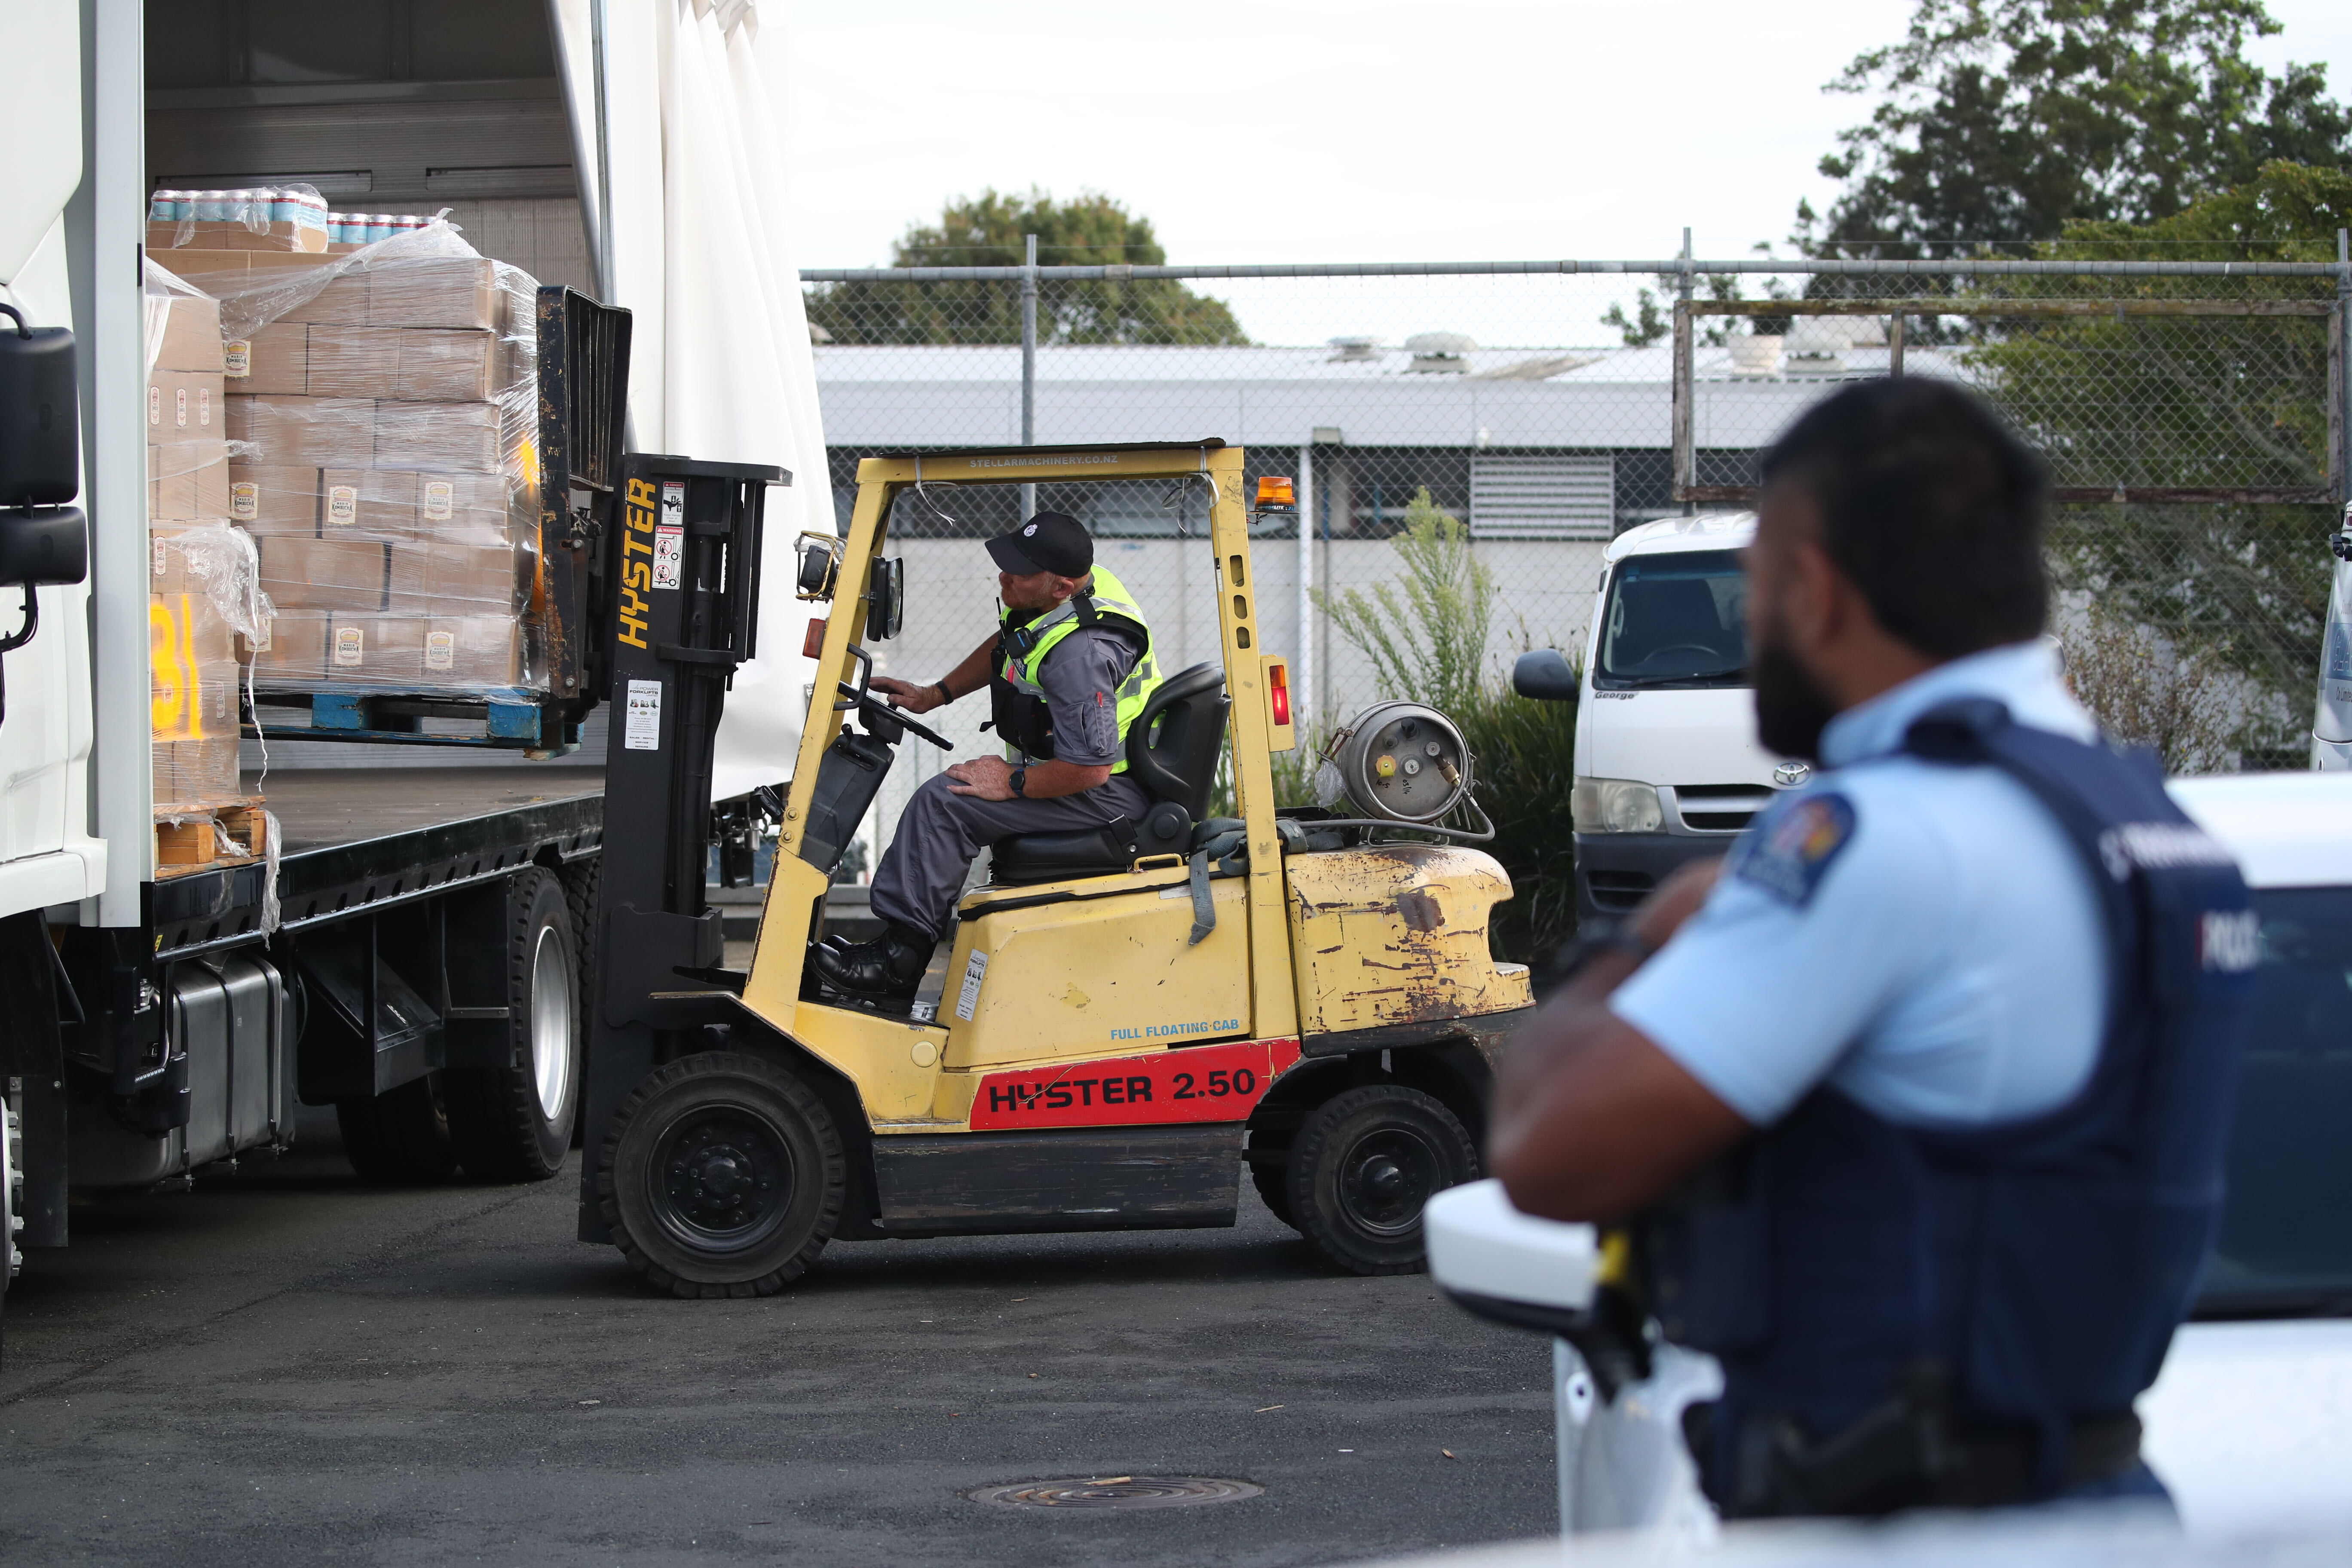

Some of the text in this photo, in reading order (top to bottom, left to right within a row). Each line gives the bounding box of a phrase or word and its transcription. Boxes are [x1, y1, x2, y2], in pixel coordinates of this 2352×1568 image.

[970, 455, 1118, 468] STELLARMACHINERY.CO.NZ
[618, 478, 656, 649] HYSTER
[2333, 629, 2352, 671] GLA
[1595, 691, 1635, 700] George
[2340, 687, 2352, 703] Limite
[1111, 1019, 1239, 1040] FULL FLOATING CAB
[989, 1069, 1256, 1112] HYSTER 2.50
